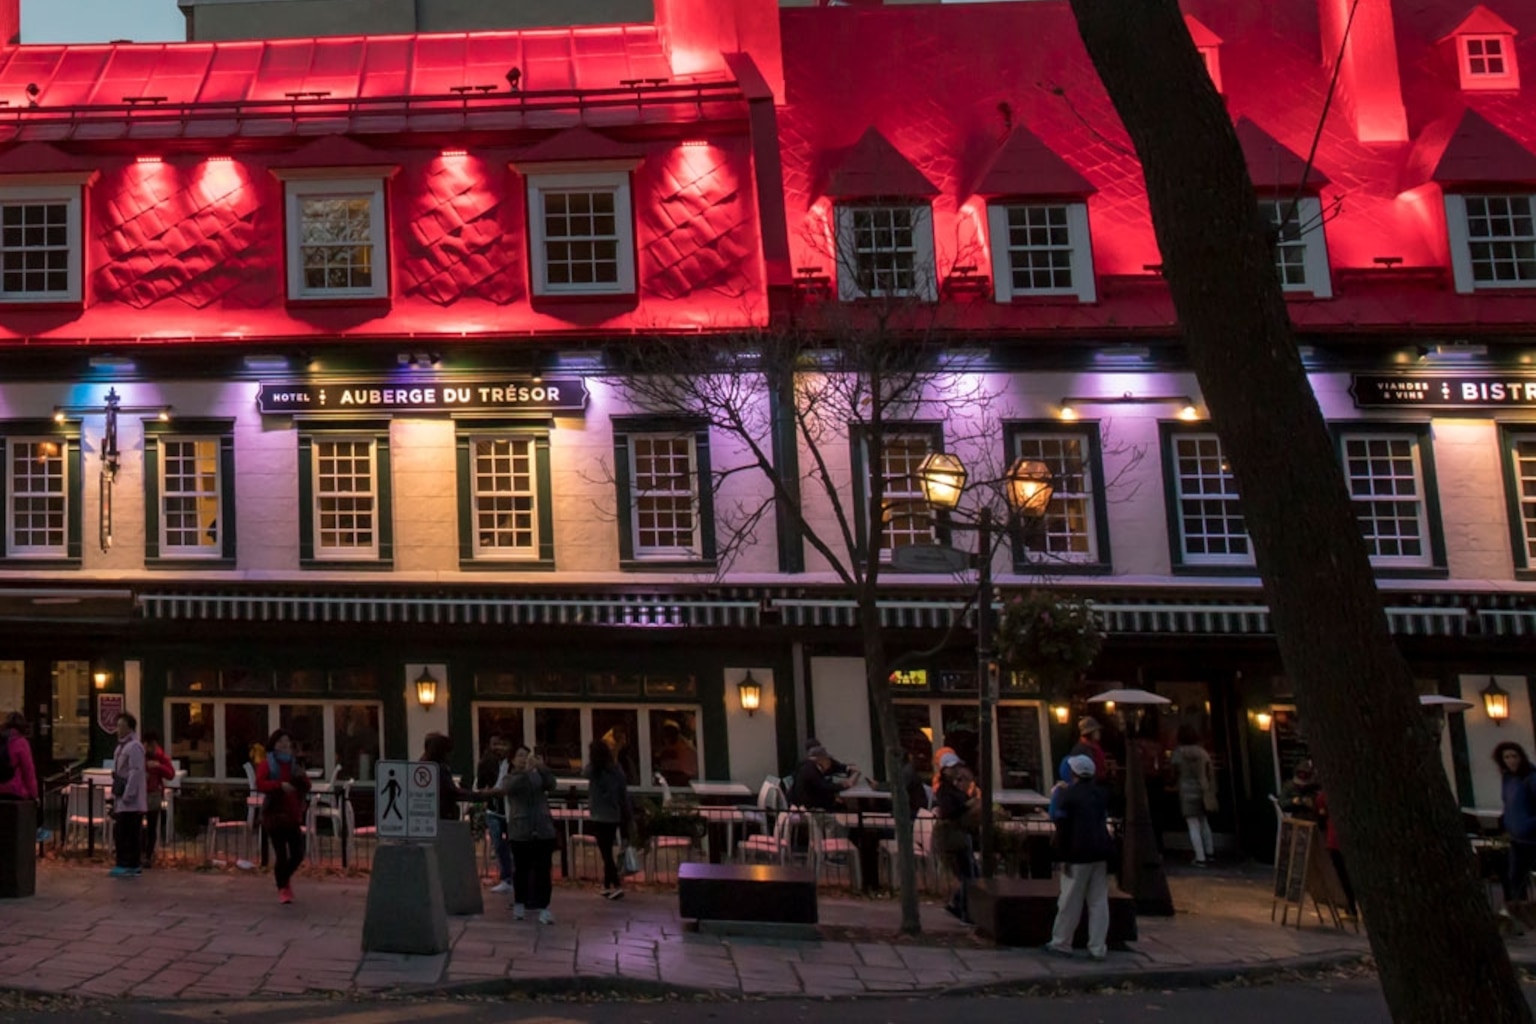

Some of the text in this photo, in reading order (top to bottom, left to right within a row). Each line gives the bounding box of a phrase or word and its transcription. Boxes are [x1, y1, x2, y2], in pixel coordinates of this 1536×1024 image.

[1377, 382, 1429, 391] VIANDES
[273, 384, 560, 405] HOTEL AUBERGE DU TRÉSOR
[1395, 391, 1425, 399] VINS
